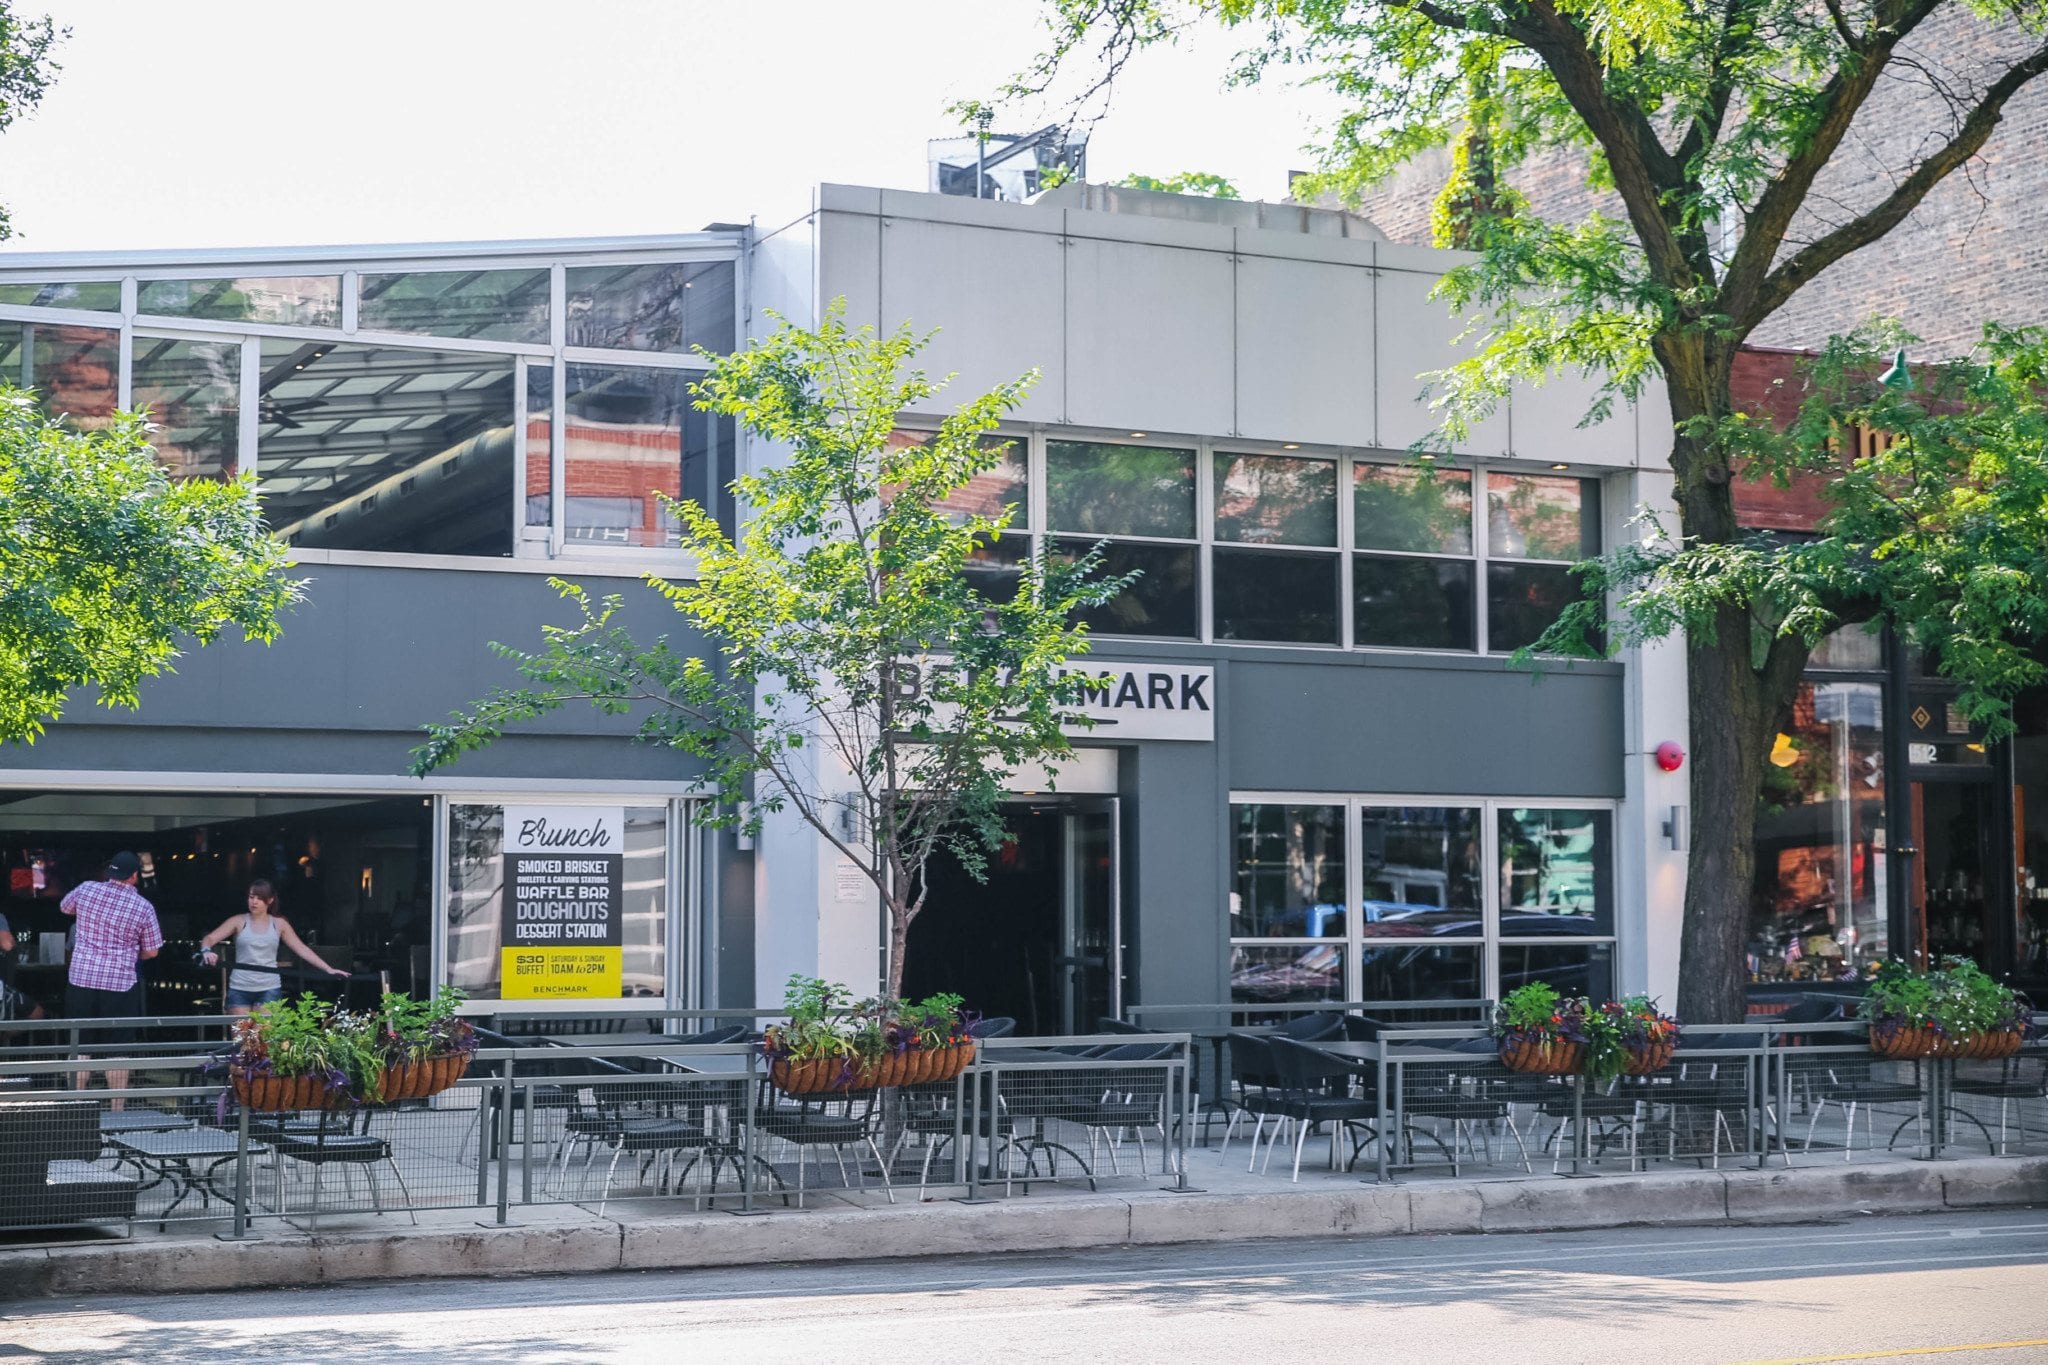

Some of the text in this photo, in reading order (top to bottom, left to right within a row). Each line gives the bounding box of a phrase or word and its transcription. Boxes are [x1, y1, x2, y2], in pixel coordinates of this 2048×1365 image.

[518, 817, 611, 847] Brunch
[517, 860, 609, 873] SMOKED BRISKET
[580, 876, 609, 884] STATIONS
[516, 886, 609, 899] WAFFLE BAR
[517, 901, 609, 920] DOUGHNUTS
[516, 923, 607, 939] DESSERT STATION
[516, 955, 545, 964] $30
[516, 965, 545, 975] BUFFET
[551, 963, 605, 974] 10AM to 2PM
[533, 985, 589, 993] BENCHMARK
